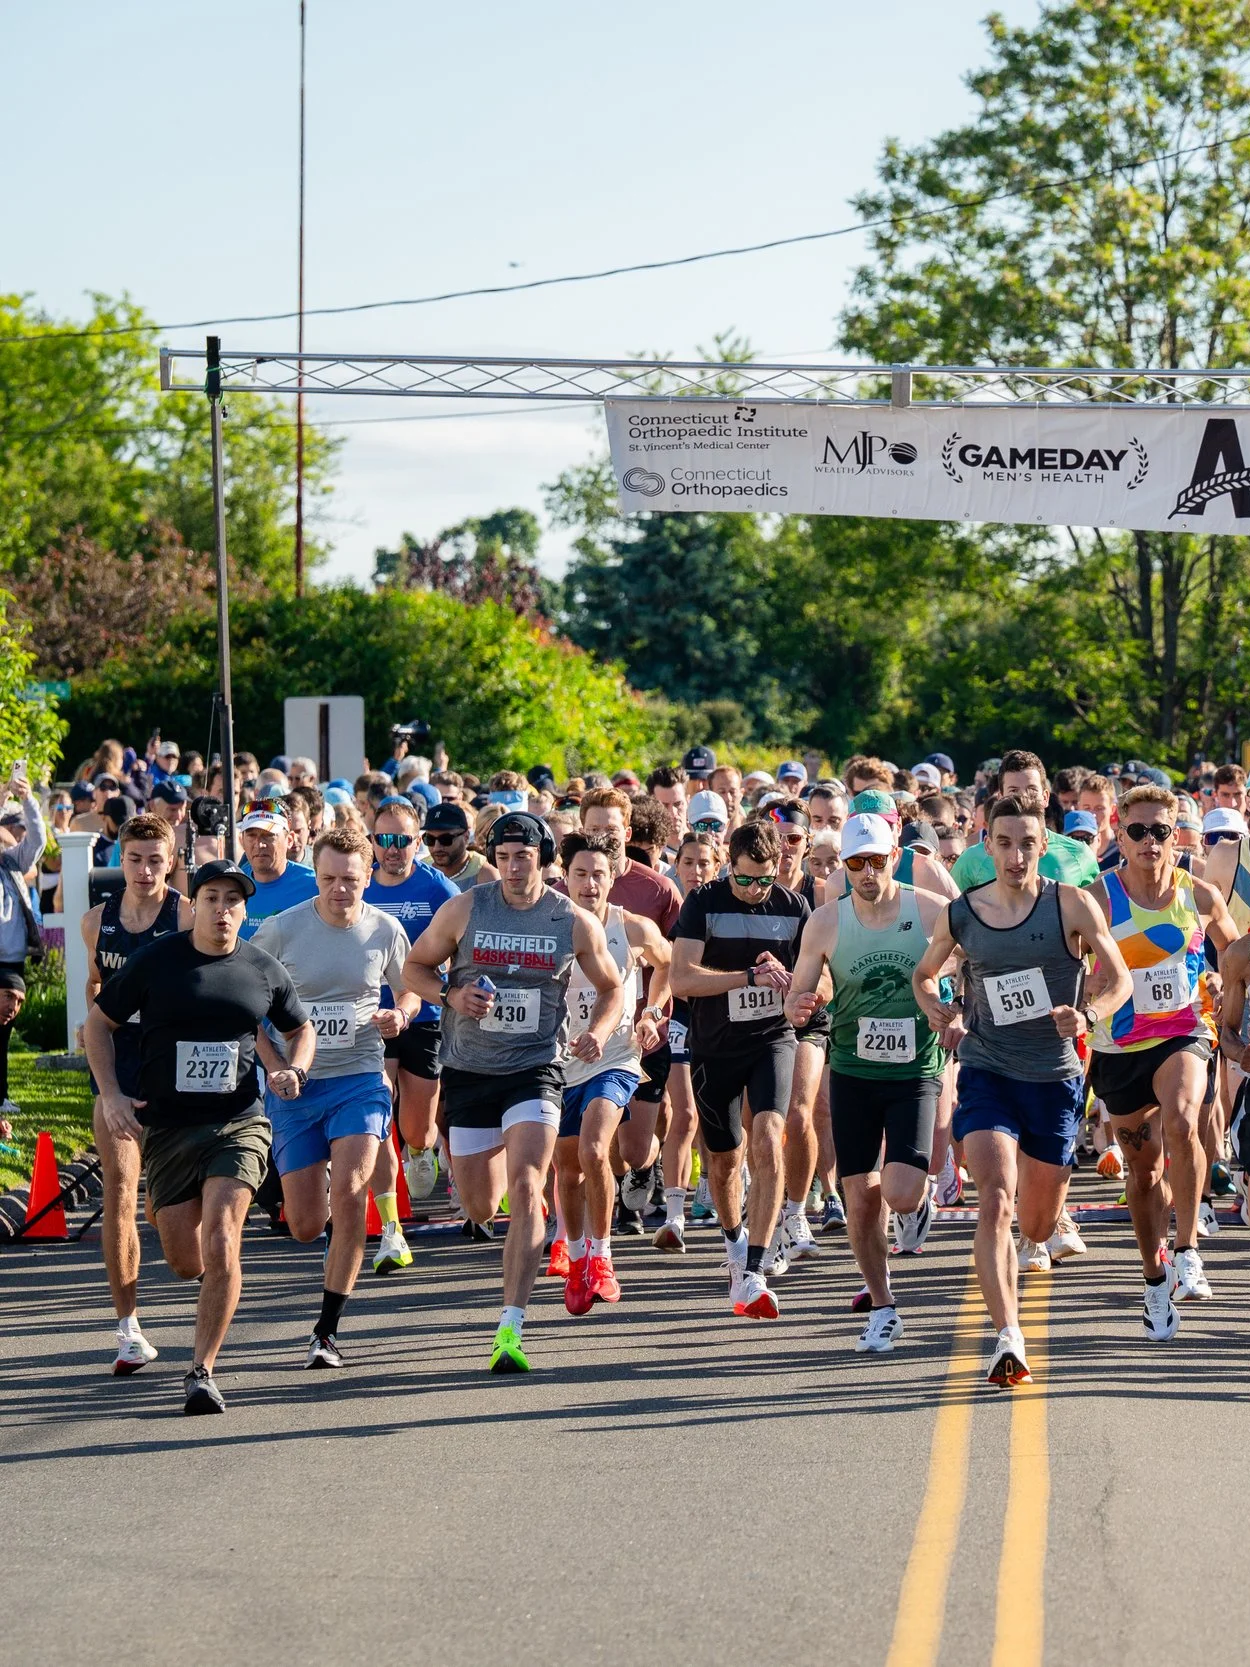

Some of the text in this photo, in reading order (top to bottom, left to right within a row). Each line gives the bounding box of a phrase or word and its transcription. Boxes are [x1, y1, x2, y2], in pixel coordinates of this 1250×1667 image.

[628, 413, 729, 426] Connecticut
[629, 426, 808, 440] Orthopaedic Institute
[693, 441, 733, 450] Medical
[736, 441, 772, 450] Center
[821, 431, 887, 476] MJP
[959, 444, 1129, 472] GAMEDAY
[670, 468, 772, 482] Connecticut
[814, 466, 914, 477] WEALTH ADVISORS
[983, 472, 1104, 484] MEN'S HEALTH
[671, 482, 788, 498] Orthopaedics
[474, 933, 557, 954] FAIRFIELD
[473, 947, 556, 967] BASKETBALL
[850, 952, 916, 976] MANCHESTER
[1005, 974, 1030, 986] ATHLETIC
[1153, 967, 1179, 978] ATHLETIC
[738, 990, 775, 1010] 1911
[1000, 989, 1035, 1012] 530
[1152, 983, 1173, 1001] 68
[494, 1006, 526, 1022] 430
[311, 1019, 349, 1036] 202
[865, 1034, 908, 1051] 2204
[186, 1060, 230, 1079] 2372
